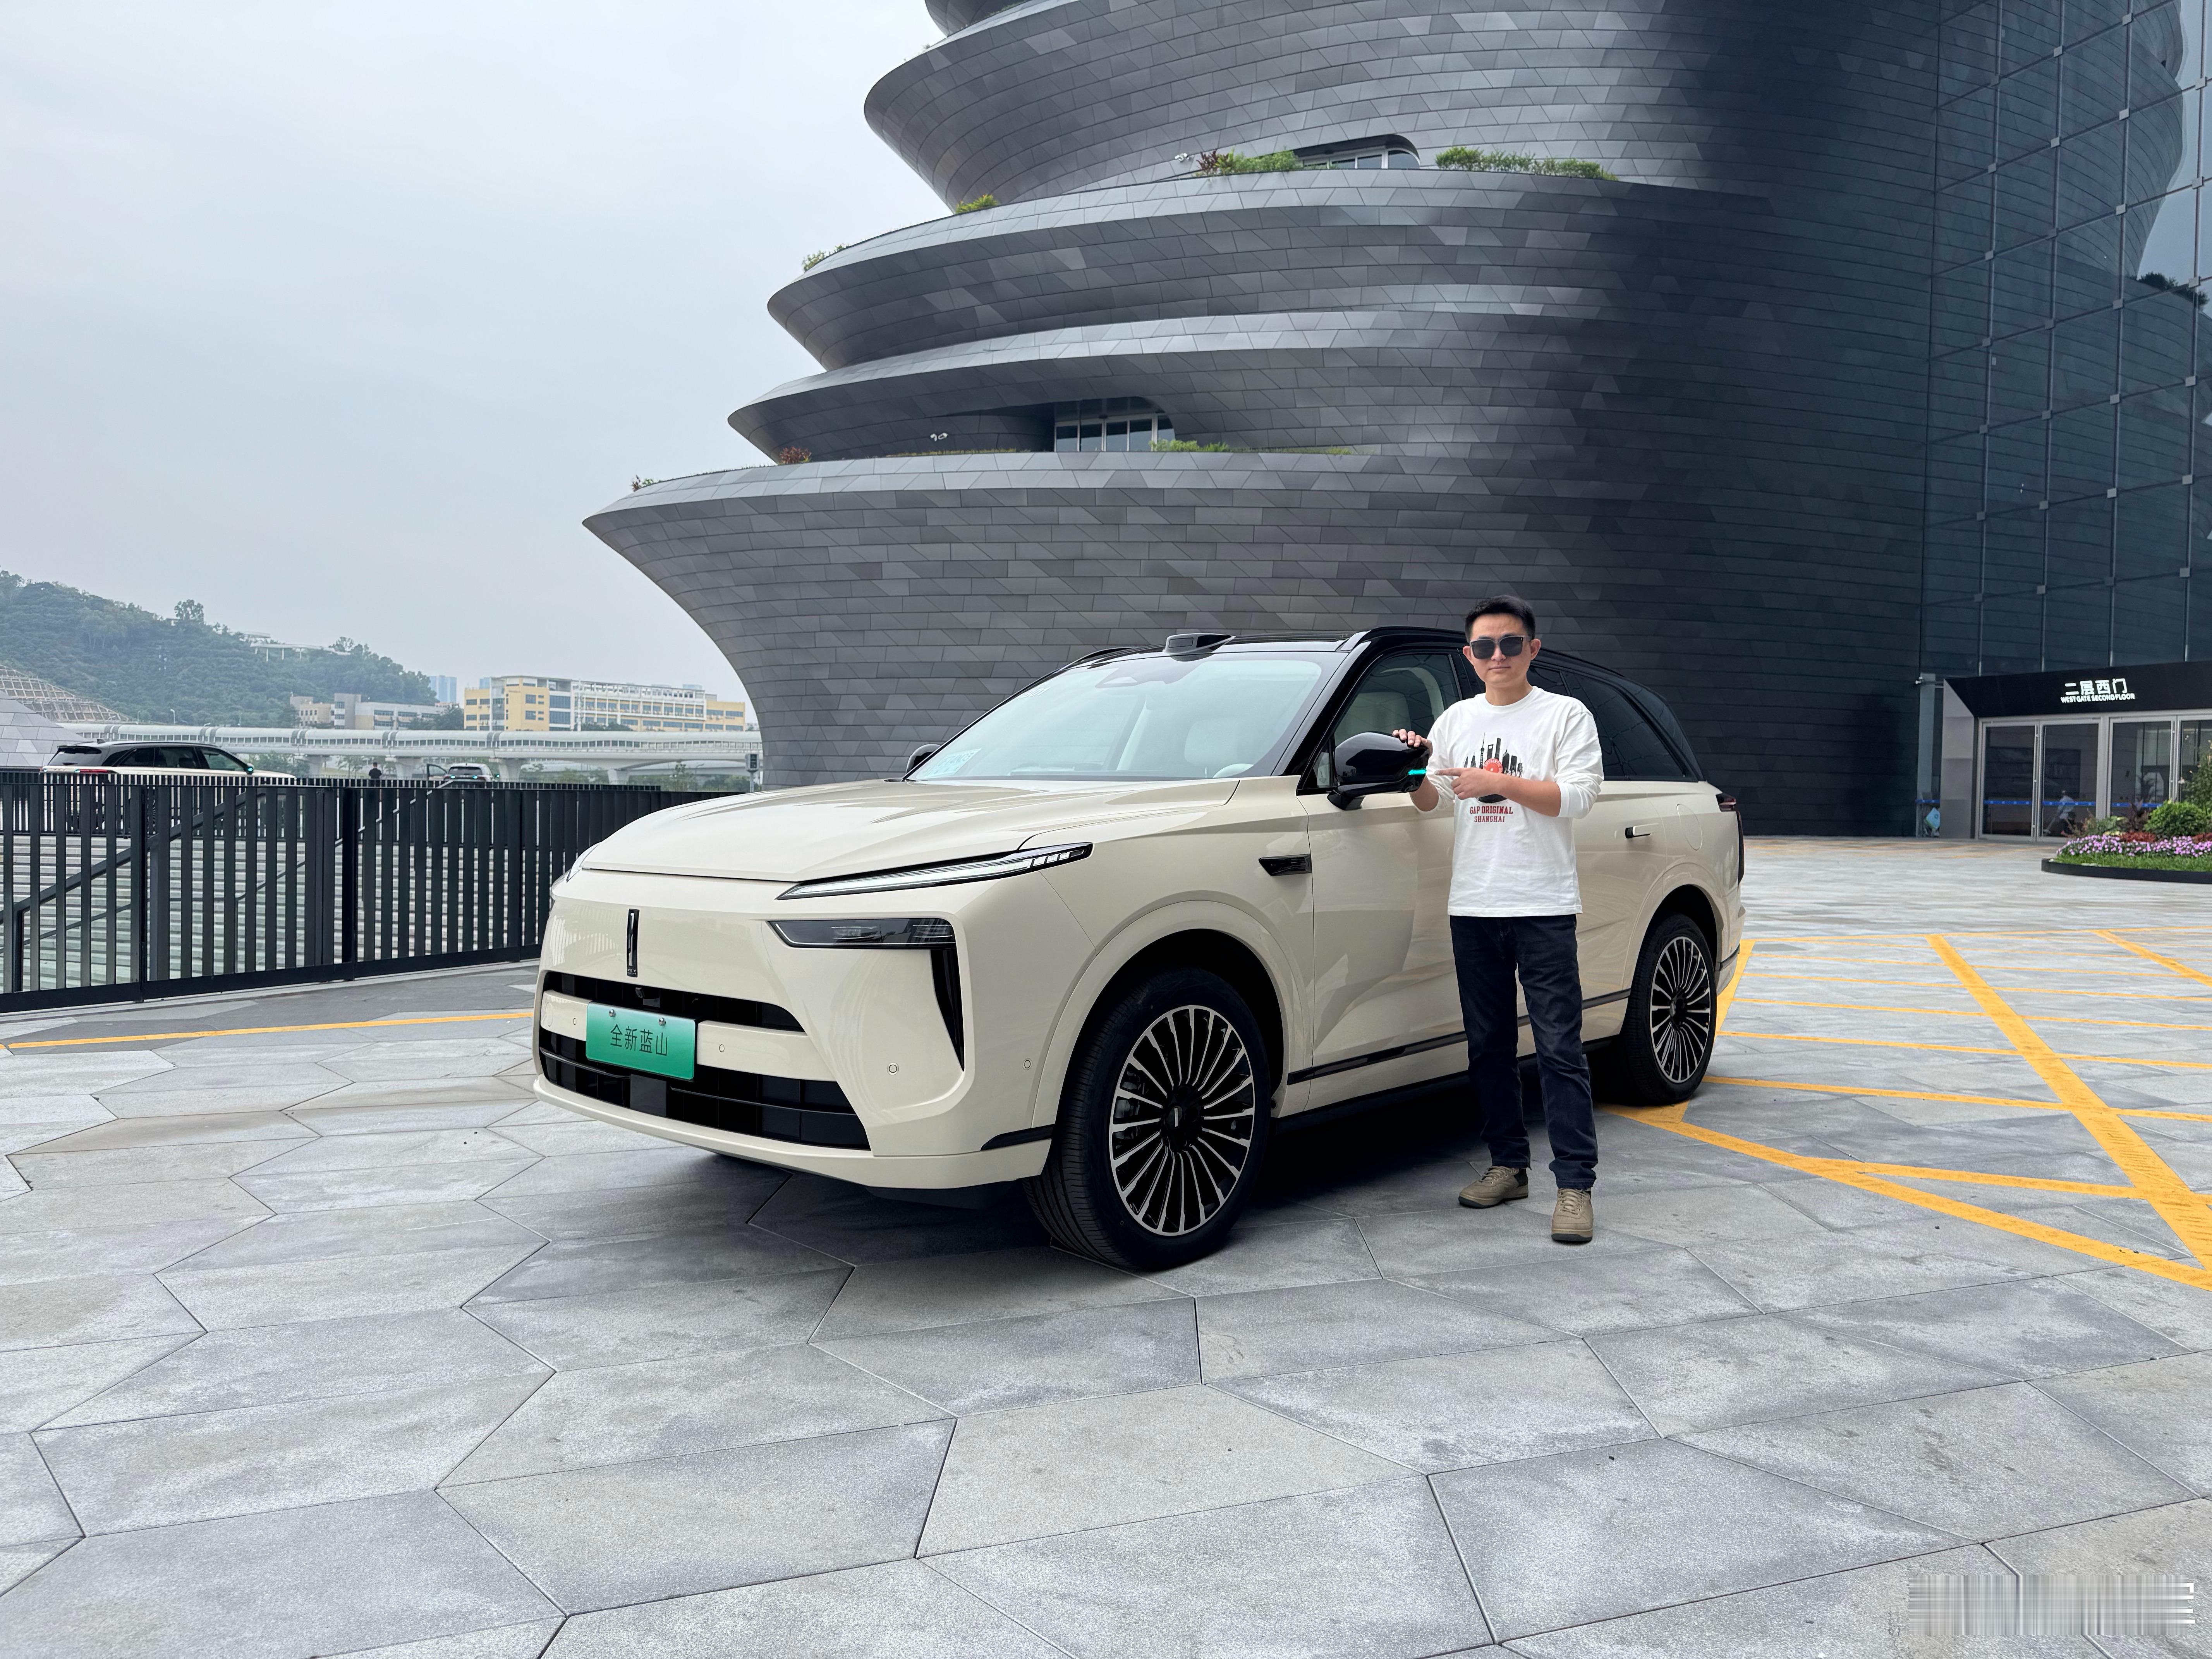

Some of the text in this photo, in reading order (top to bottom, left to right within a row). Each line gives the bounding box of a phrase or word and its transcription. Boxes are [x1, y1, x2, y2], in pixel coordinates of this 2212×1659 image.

[2064, 678, 2128, 696] 二层西门
[1470, 805, 1513, 814] GAP ORIGINAL
[610, 1024, 668, 1056] 全新蓝山
